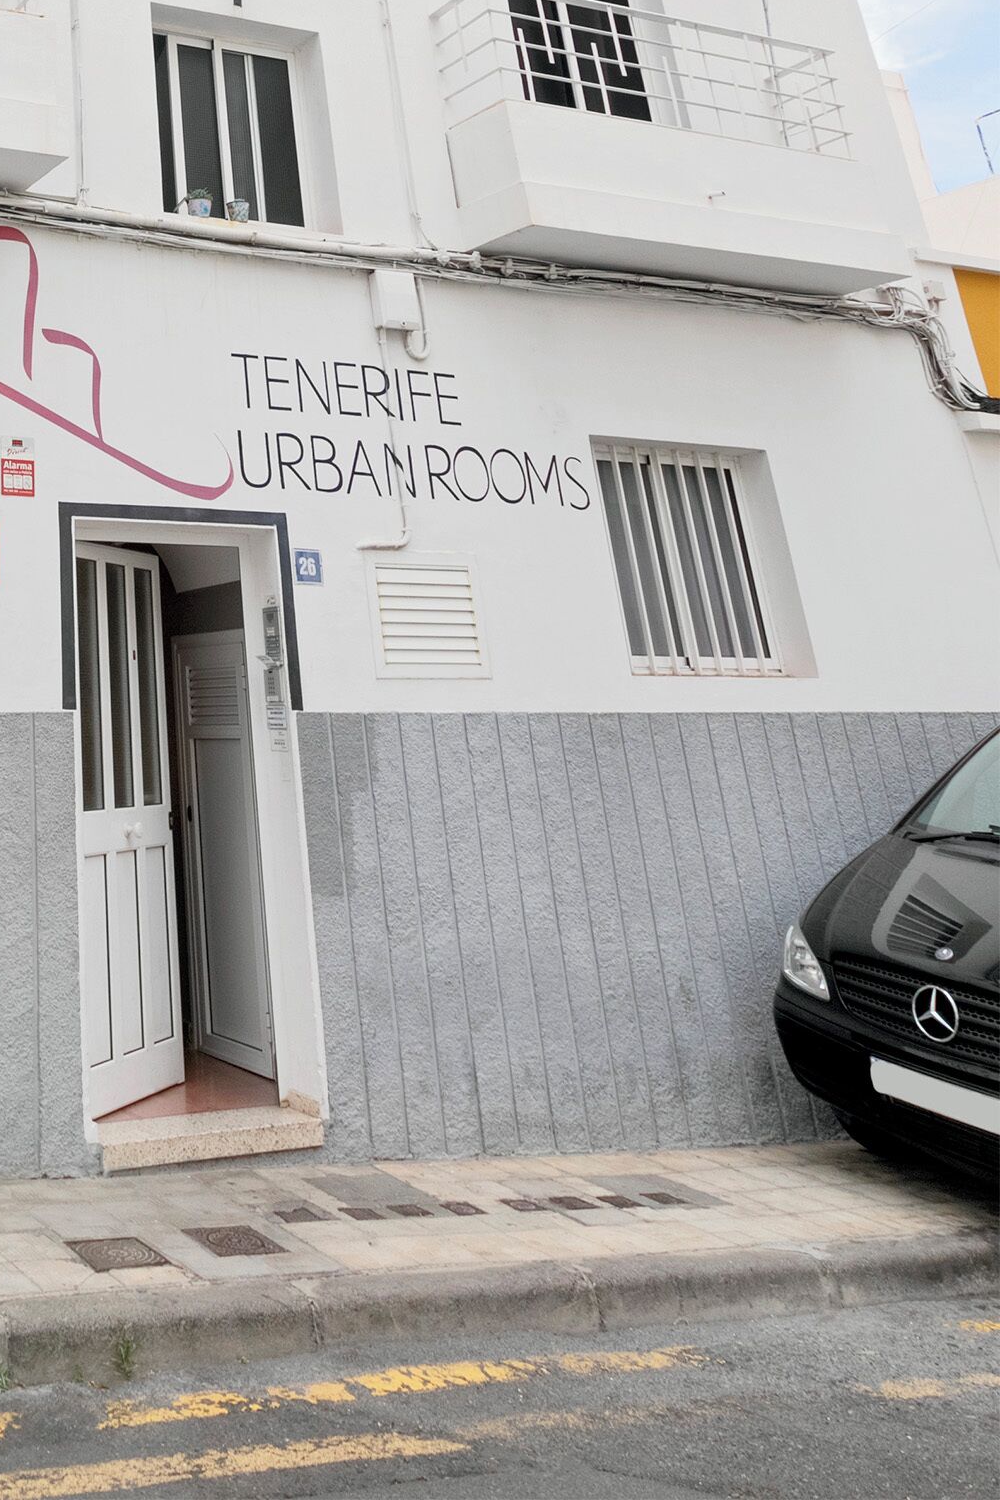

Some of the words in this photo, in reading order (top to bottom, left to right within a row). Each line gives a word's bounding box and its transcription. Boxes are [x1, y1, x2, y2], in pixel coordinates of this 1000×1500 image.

[231, 353, 462, 426] TENERIFE
[3, 460, 33, 471] Alarma
[298, 556, 317, 576] 26
